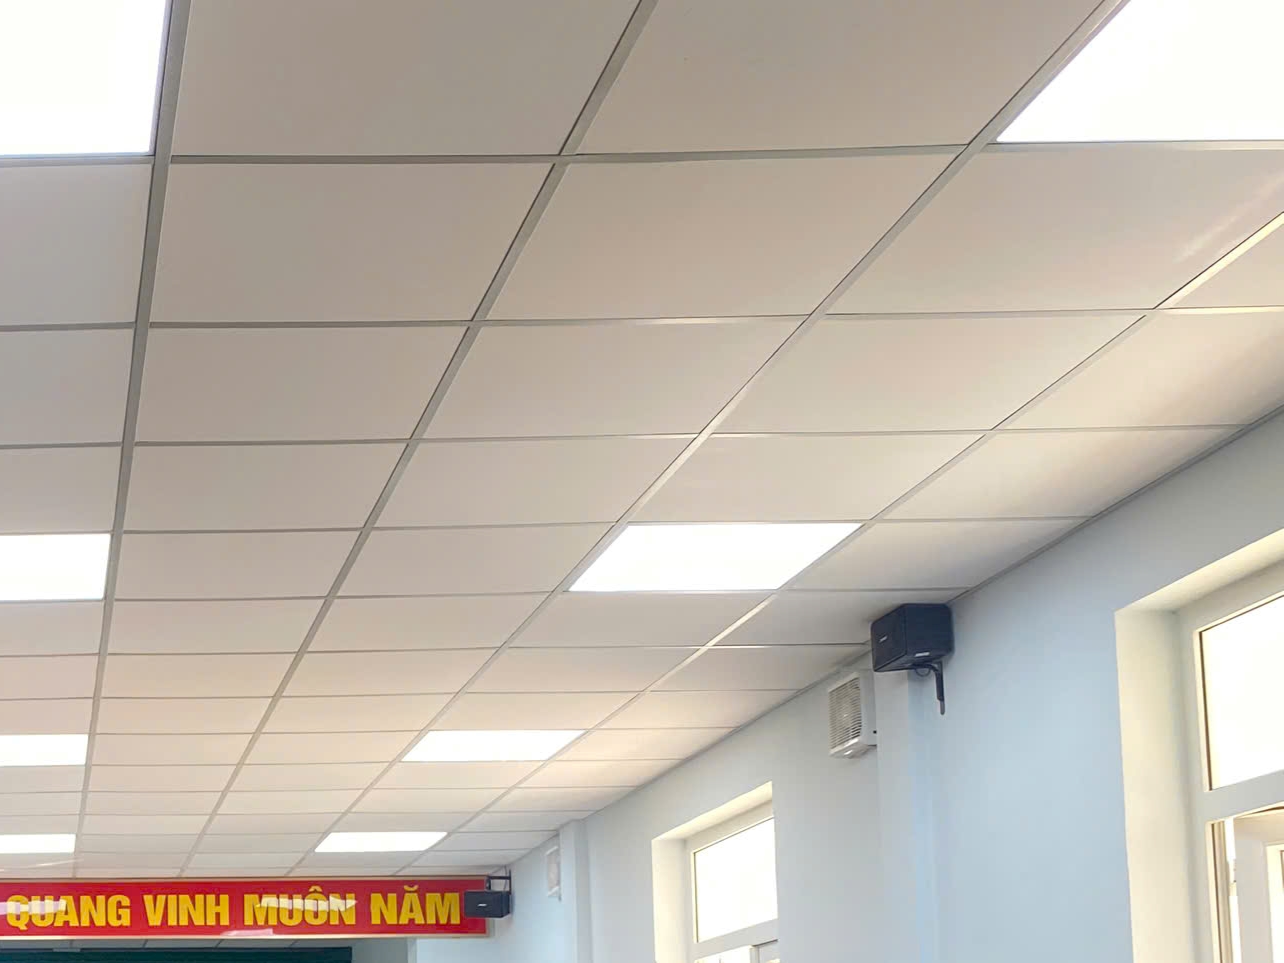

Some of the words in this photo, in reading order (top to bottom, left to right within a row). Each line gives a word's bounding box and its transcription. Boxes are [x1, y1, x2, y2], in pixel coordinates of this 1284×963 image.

[6, 894, 131, 931] QUANG
[144, 894, 230, 926] VINH
[244, 886, 356, 926] MUÔN
[370, 885, 461, 925] NĂM
